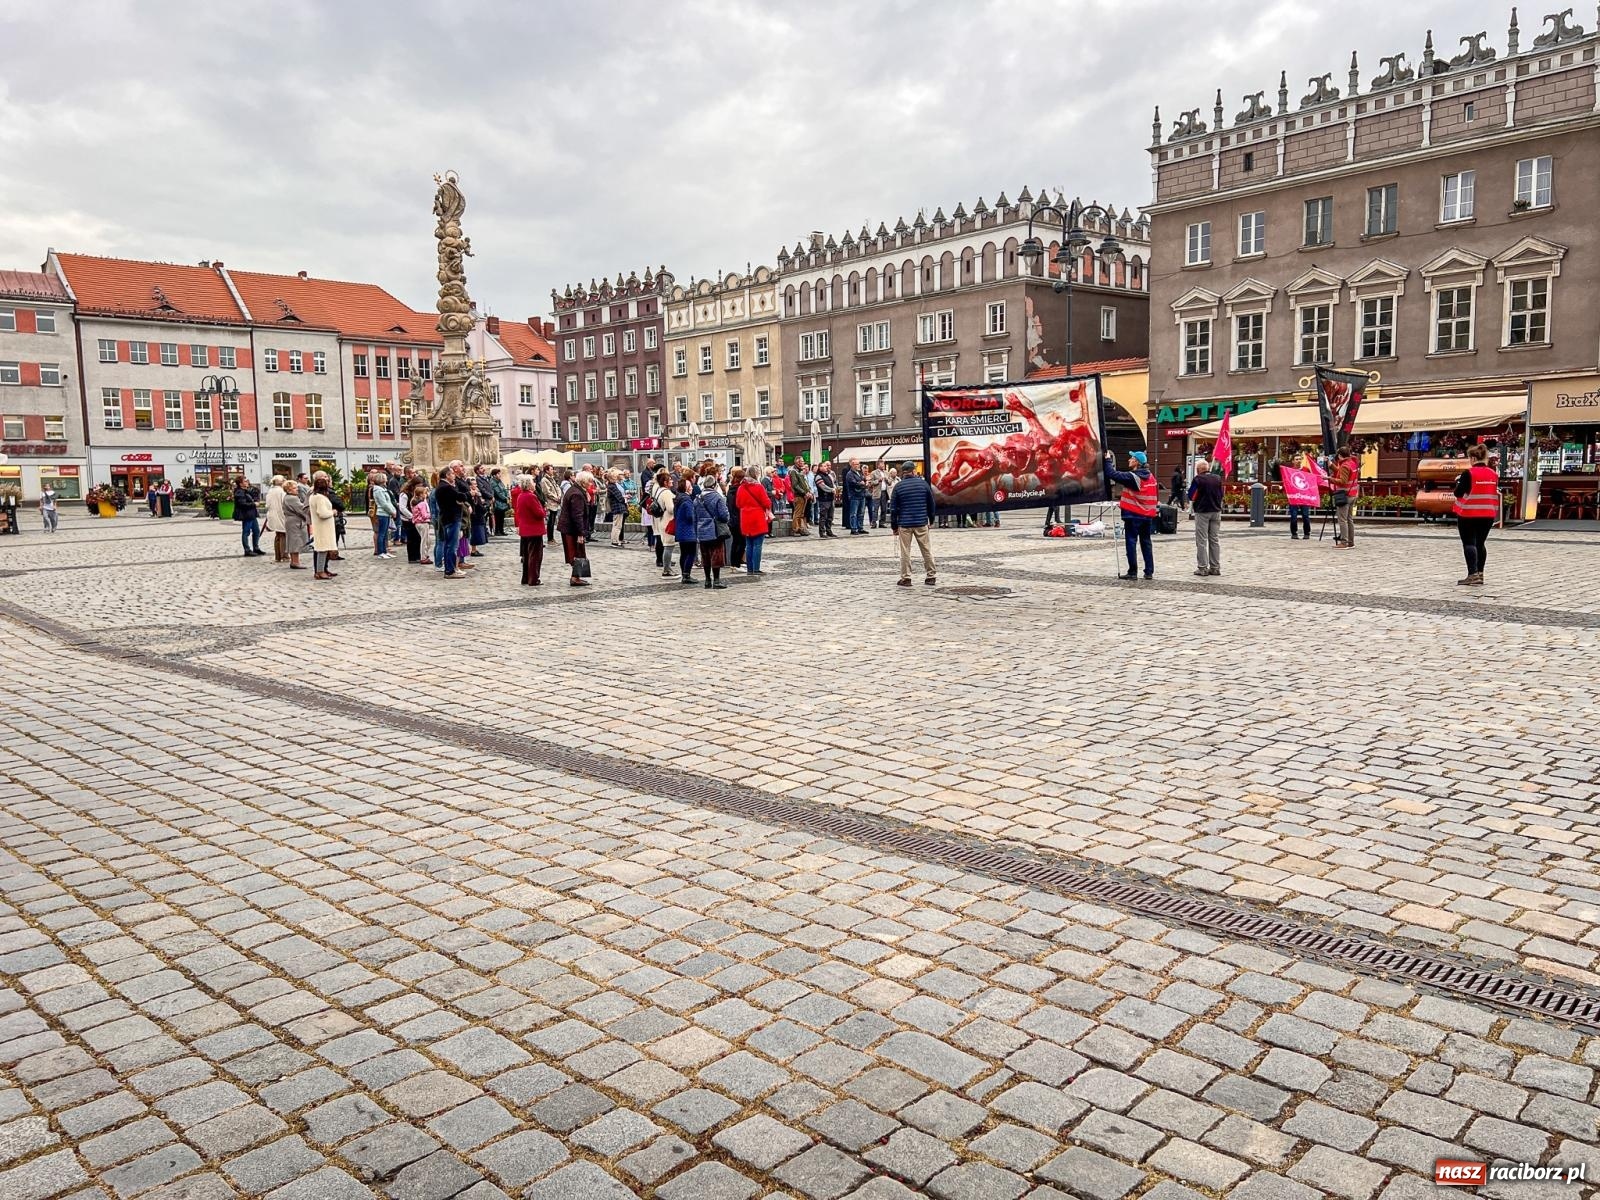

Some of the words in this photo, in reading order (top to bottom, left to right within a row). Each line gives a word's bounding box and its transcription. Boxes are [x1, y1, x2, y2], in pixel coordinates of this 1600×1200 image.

[933, 396, 999, 410] ABORCJA
[1158, 398, 1277, 423] APTEK
[945, 416, 969, 425] KARA
[970, 413, 1009, 424] ŚMIERCI
[937, 428, 958, 437] DLA
[960, 424, 1019, 435] NIEWINNYCH
